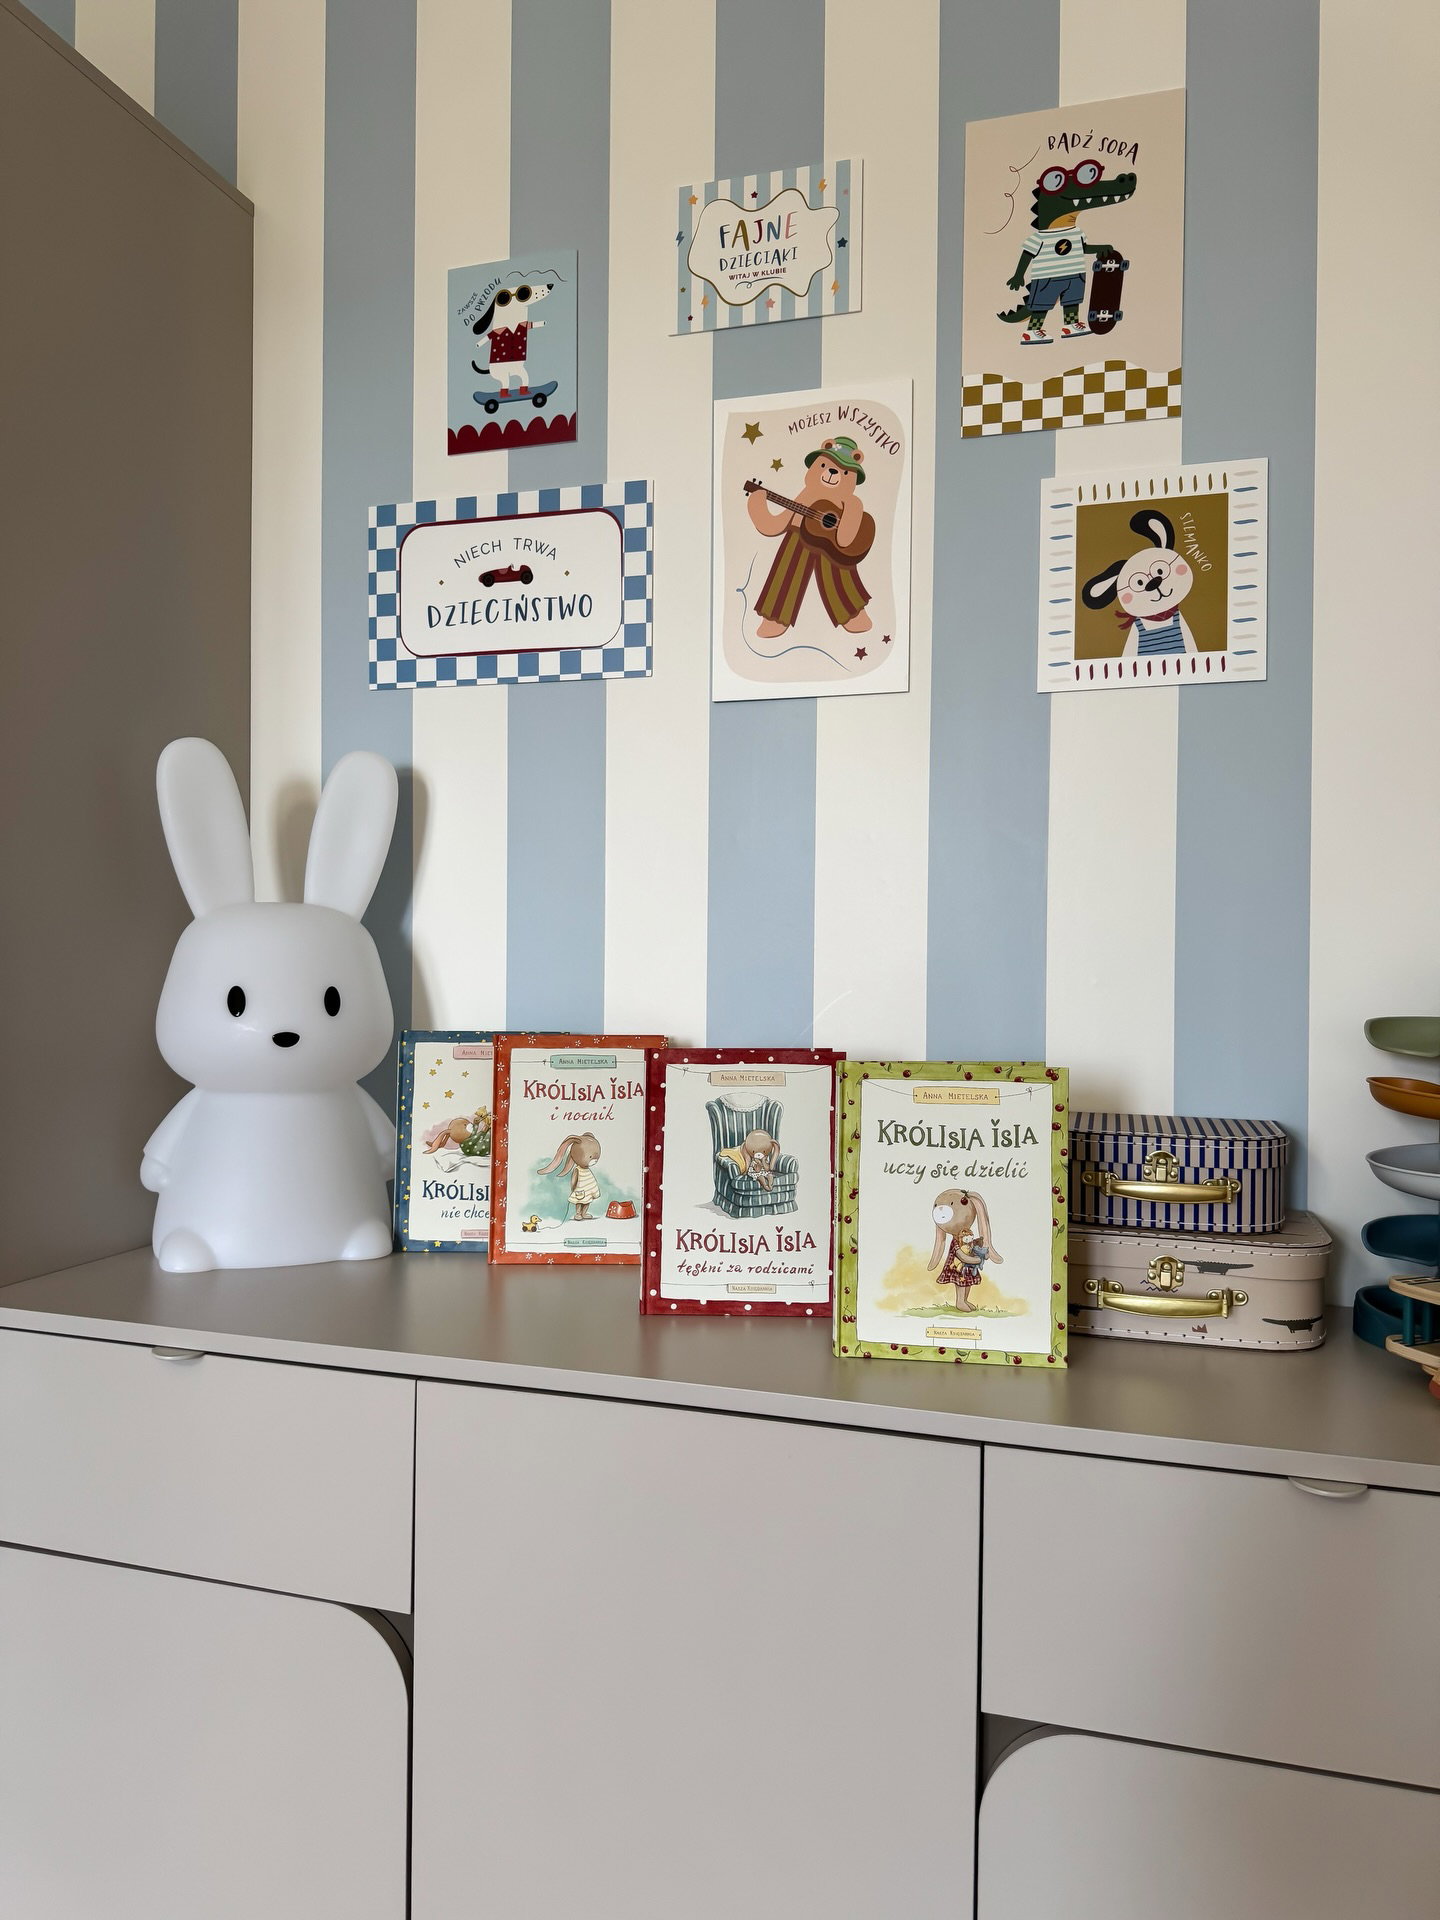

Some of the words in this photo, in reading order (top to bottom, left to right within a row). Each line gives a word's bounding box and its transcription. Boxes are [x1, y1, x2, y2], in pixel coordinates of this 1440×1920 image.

[719, 210, 798, 252] FAJNE
[719, 246, 798, 272] DZIECIAKI
[728, 272, 751, 281] WITAJ
[761, 267, 787, 277] KLUBIE
[463, 313, 476, 327] DO
[788, 411, 832, 436] MOŻESZ
[838, 405, 901, 456] WSZYSTKO
[453, 539, 502, 569] NIECH
[513, 537, 557, 561] TRWA
[1179, 511, 1213, 572] SIEMANKO
[427, 593, 593, 629] DZIECIŃSTWO
[720, 1073, 738, 1081] ANNA
[523, 1078, 606, 1103] KRÓLISIA
[922, 1091, 943, 1100] ANNA
[948, 1092, 989, 1101] MIETELSKA
[550, 1106, 559, 1121] i
[563, 1103, 615, 1121] nocnik
[877, 1118, 986, 1152] KRÓLISIA
[883, 1161, 927, 1185] uczy
[930, 1159, 960, 1181] się
[964, 1157, 1030, 1179] dzielić
[422, 1179, 489, 1202] KRÓLISI
[440, 1206, 461, 1219] nie
[675, 1227, 771, 1256] KRÓLISIA
[726, 1264, 743, 1274] za
[747, 1260, 815, 1275] rodzicami
